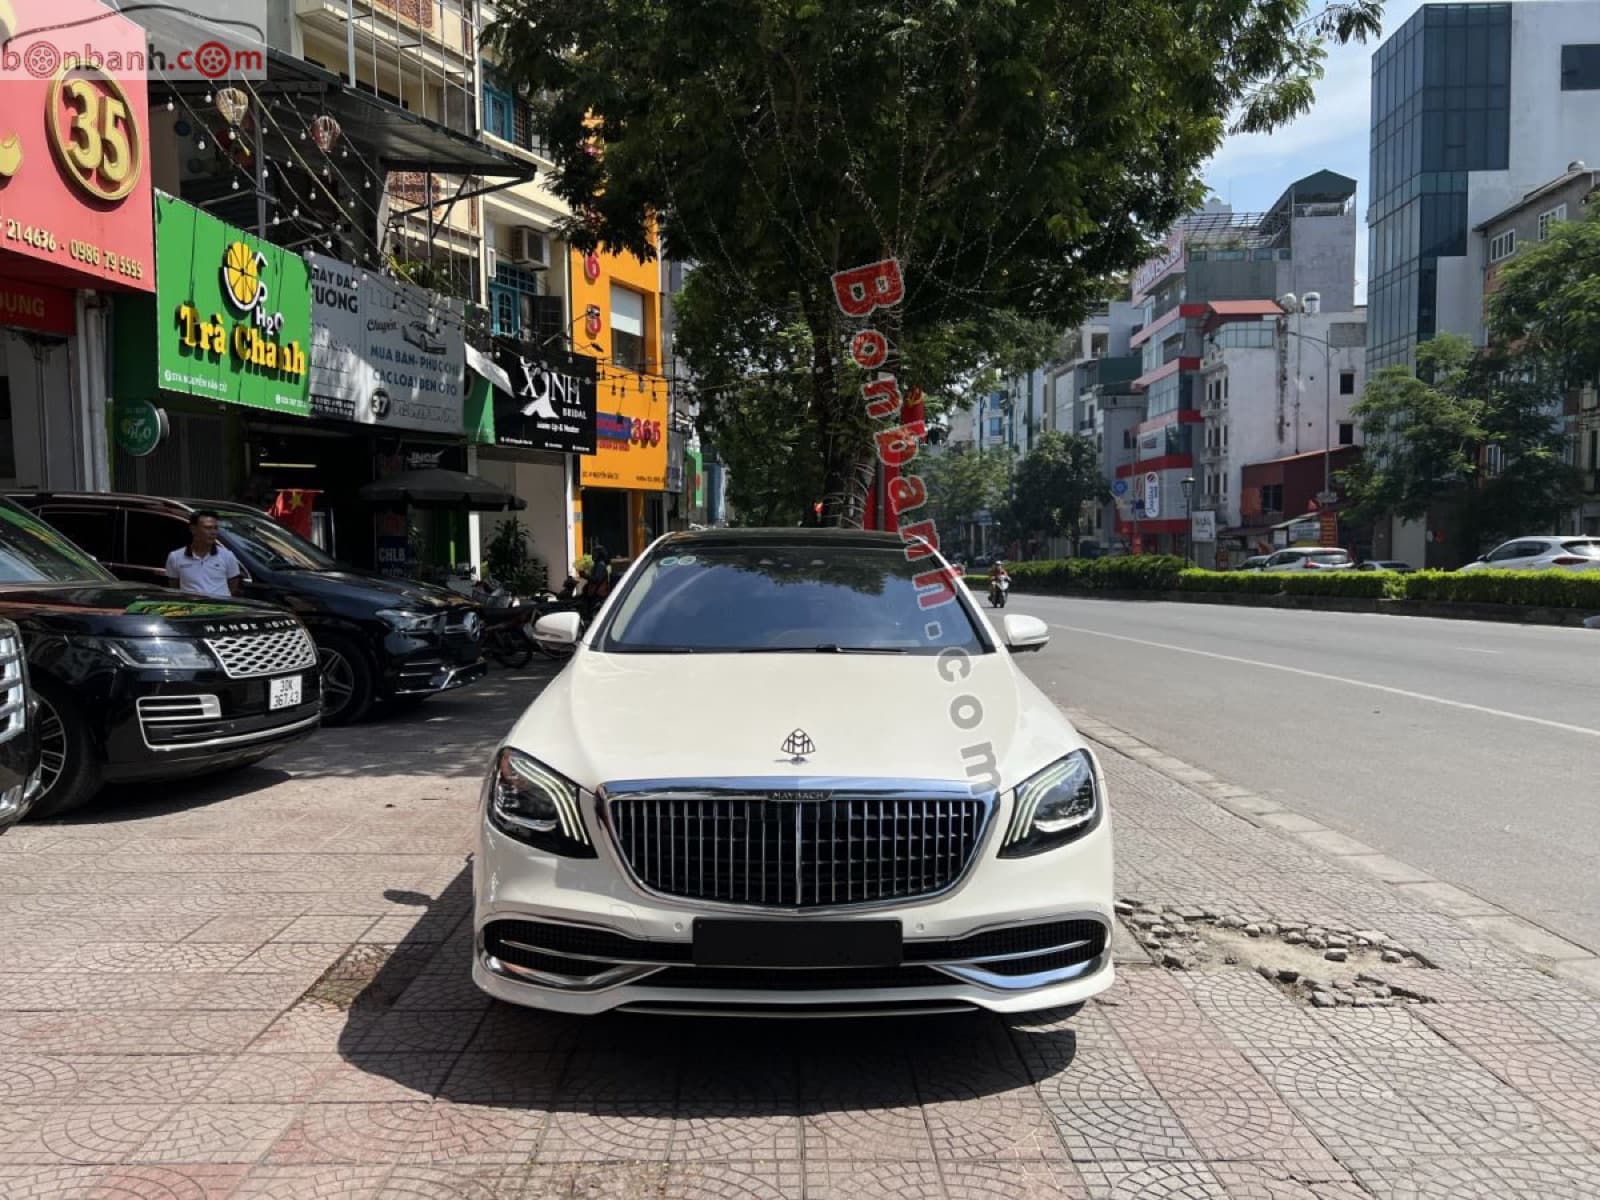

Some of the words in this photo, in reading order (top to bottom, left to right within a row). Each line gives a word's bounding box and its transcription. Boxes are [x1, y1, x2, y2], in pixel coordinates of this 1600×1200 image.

[62, 79, 126, 182] 35
[180, 304, 226, 355] Trà
[234, 323, 305, 376] Chanh
[372, 395, 388, 414] 37
[630, 416, 661, 446] 365
[771, 791, 824, 800] MAYBACH
